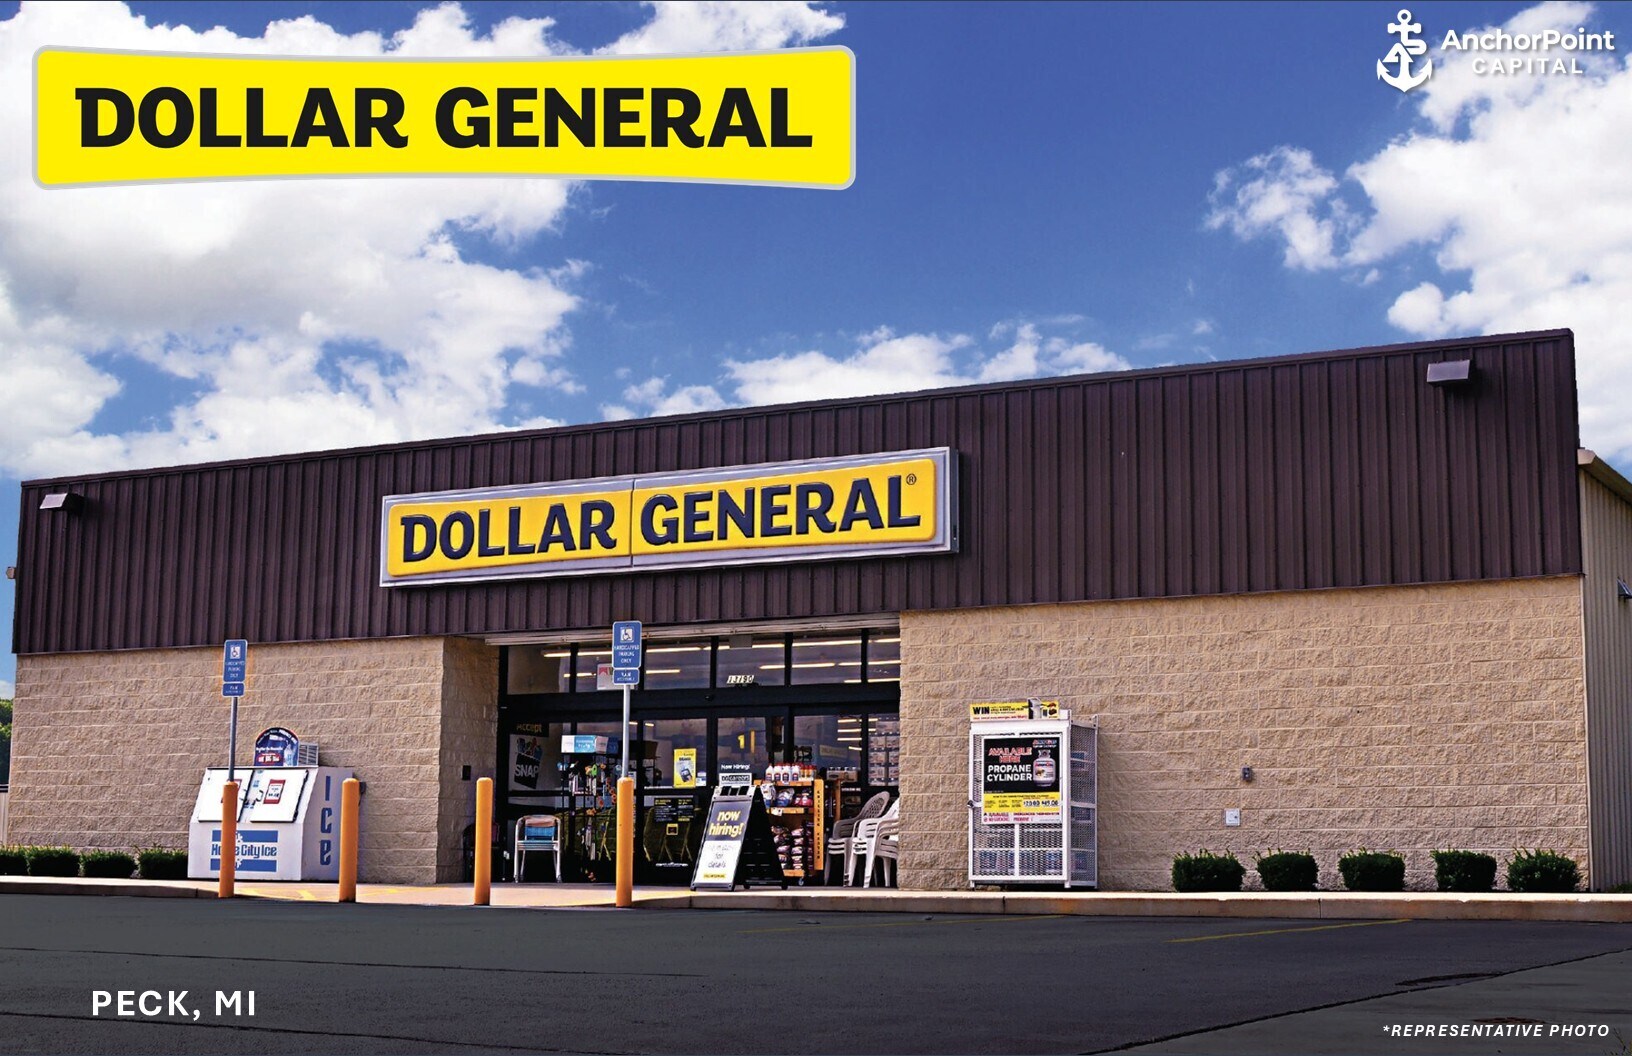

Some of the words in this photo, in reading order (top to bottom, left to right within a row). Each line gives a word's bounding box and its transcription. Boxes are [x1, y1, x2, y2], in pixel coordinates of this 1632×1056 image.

[400, 499, 617, 563] DOLLAR
[640, 474, 921, 546] GENERAL
[972, 706, 990, 715] WIN
[988, 747, 1032, 756] AVAILABLE
[515, 764, 539, 778] SNAP
[988, 765, 1032, 773] PROPANE
[986, 773, 1033, 782] CYLINDER
[717, 810, 742, 821] now
[708, 822, 745, 838] hiring!
[241, 844, 260, 859] City
[261, 844, 277, 857] Ice
